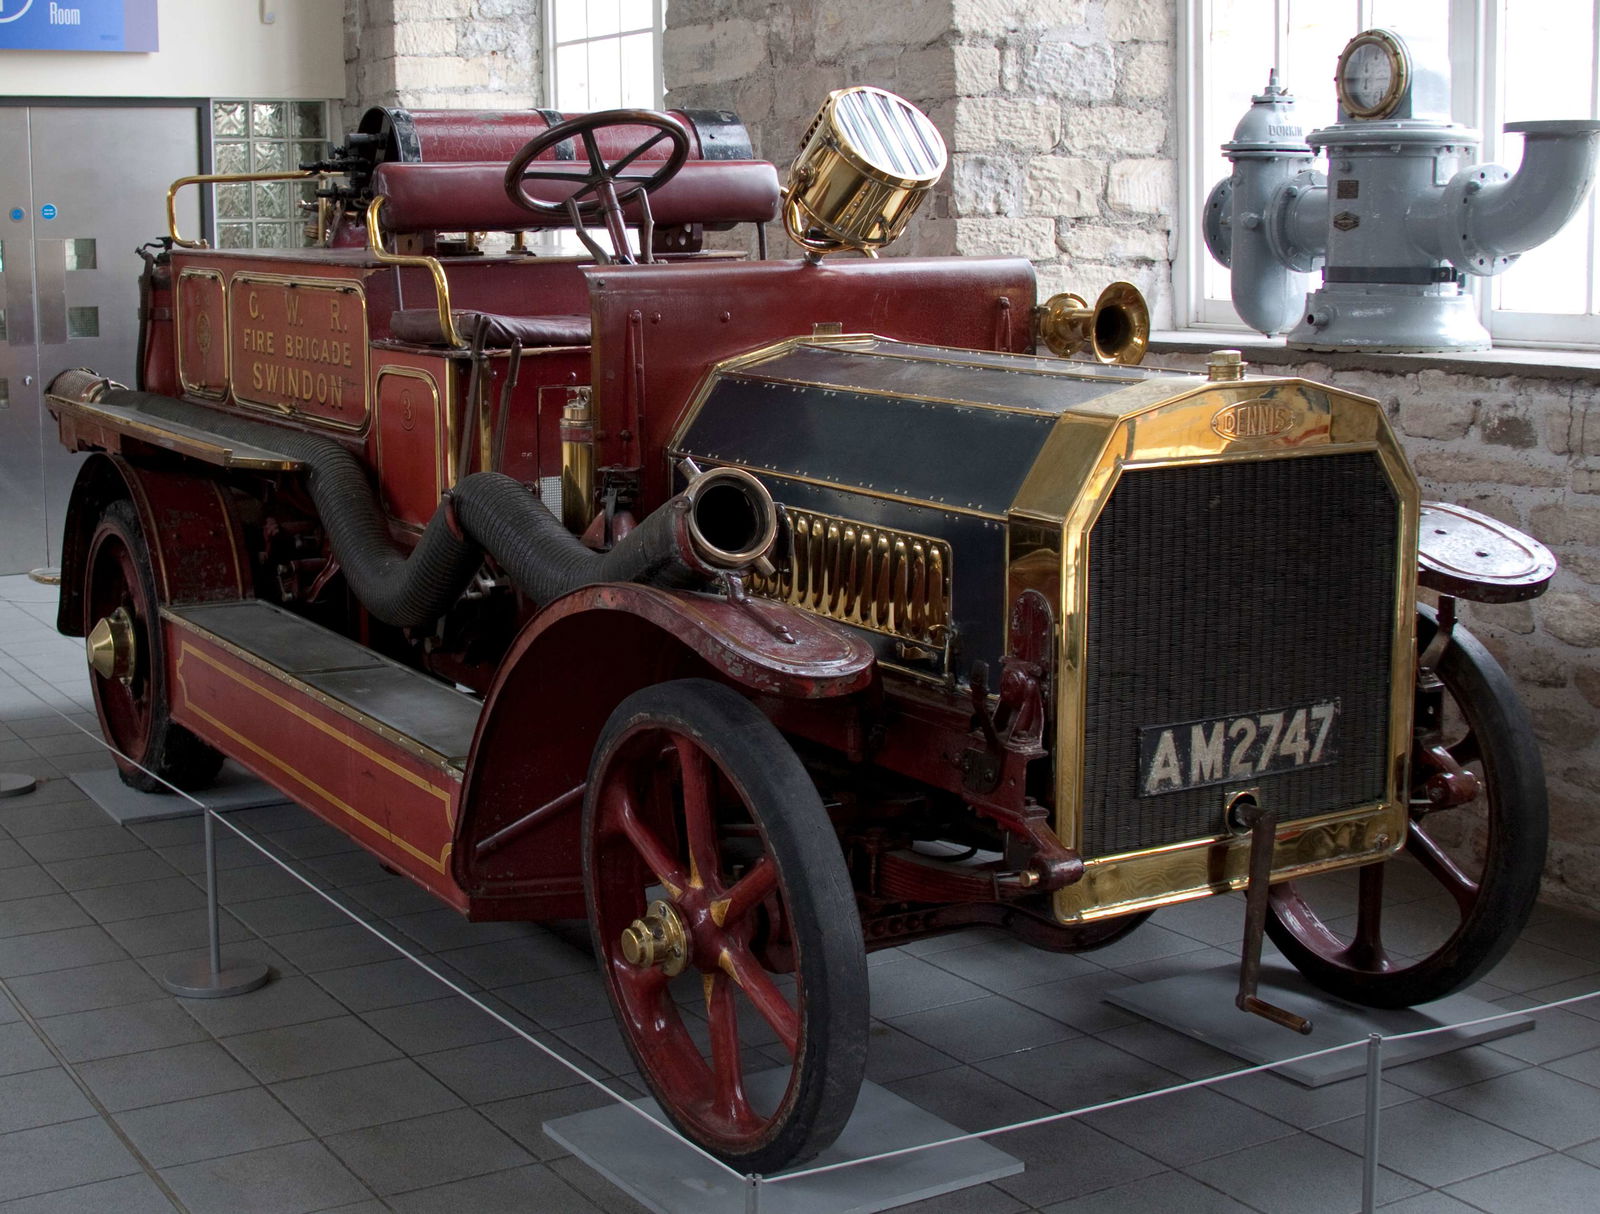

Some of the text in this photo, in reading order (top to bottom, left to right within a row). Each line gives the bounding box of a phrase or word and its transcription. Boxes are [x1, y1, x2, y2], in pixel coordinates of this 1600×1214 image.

[49, 1, 81, 26] Room
[243, 327, 353, 368] FIRE BRIGADE
[252, 360, 343, 410] SWINDON
[402, 397, 413, 421] 3
[1222, 405, 1288, 437] DENNIS
